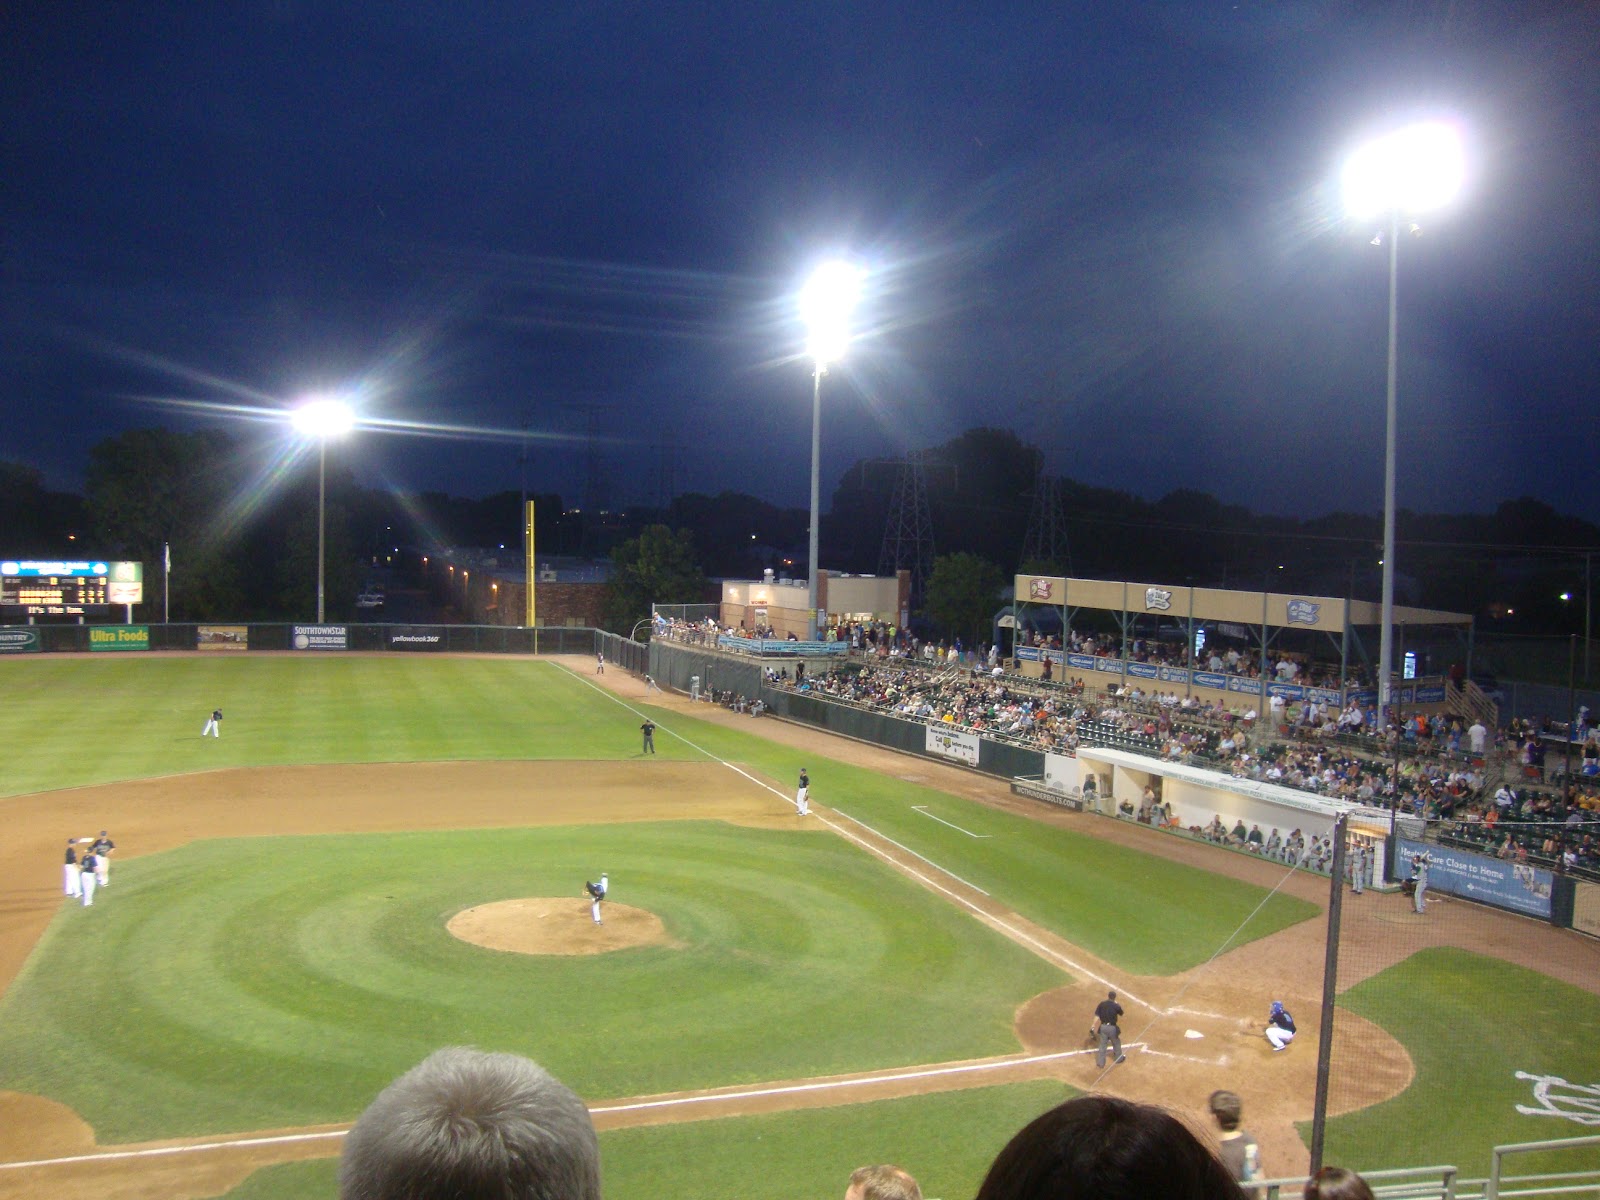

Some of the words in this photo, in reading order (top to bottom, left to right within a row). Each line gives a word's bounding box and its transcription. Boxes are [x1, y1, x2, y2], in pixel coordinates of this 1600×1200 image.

[48, 606, 64, 614] the
[90, 630, 115, 642] Ultra
[118, 630, 148, 641] Foods
[1400, 846, 1424, 858] Healt
[1426, 853, 1444, 865] Care
[1446, 858, 1467, 869] Close
[1468, 864, 1478, 872] to
[1480, 866, 1504, 879] Home
